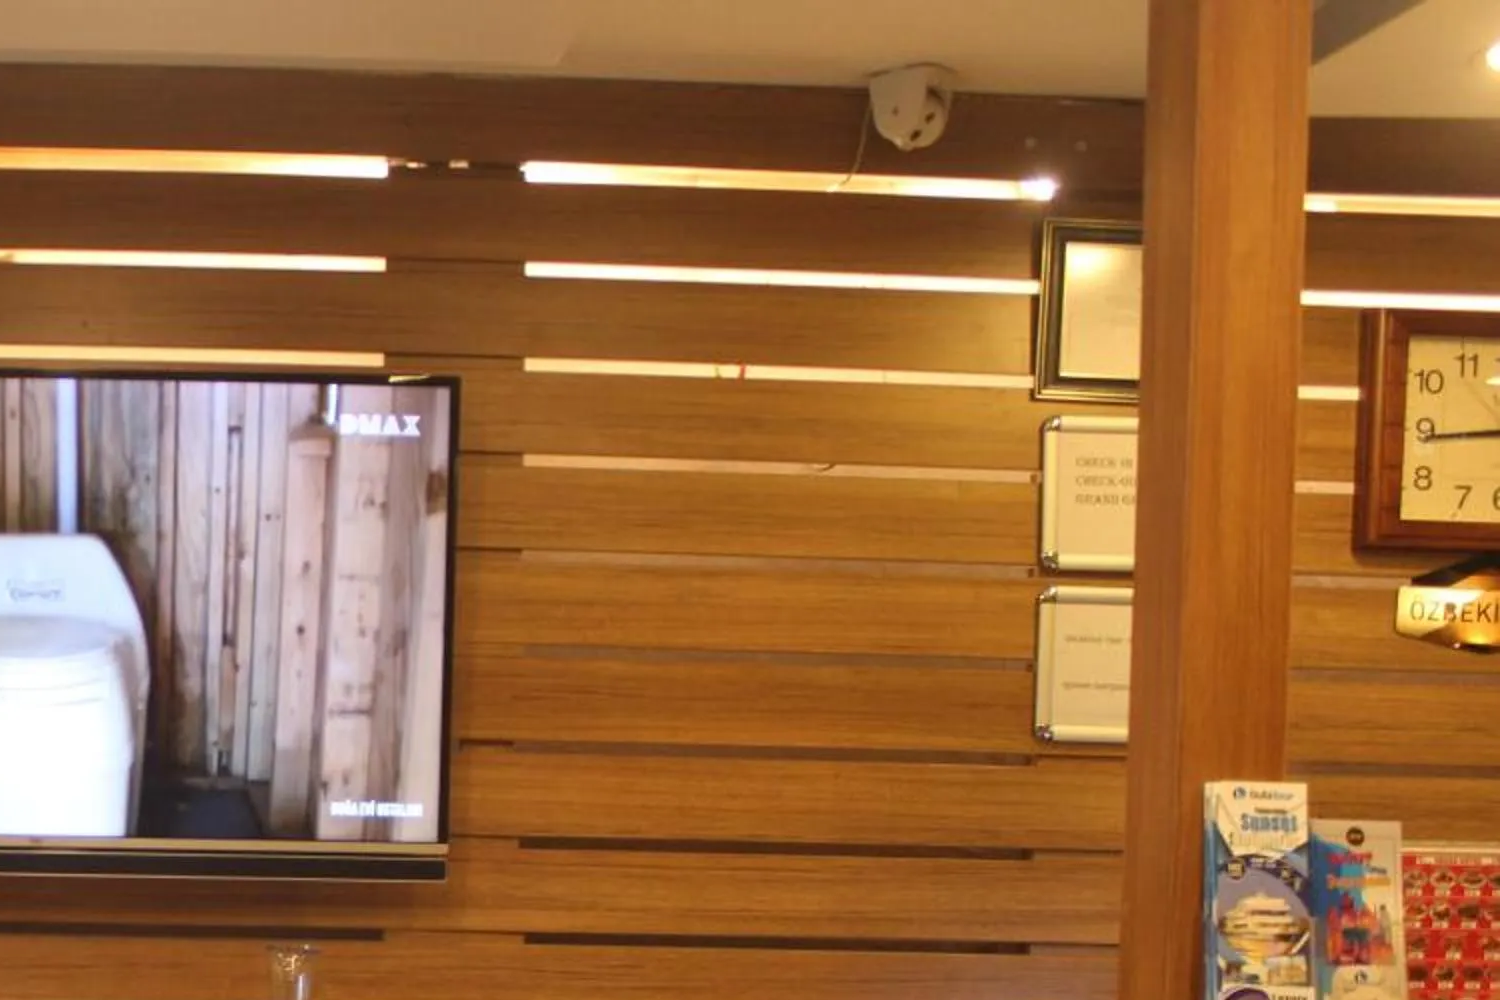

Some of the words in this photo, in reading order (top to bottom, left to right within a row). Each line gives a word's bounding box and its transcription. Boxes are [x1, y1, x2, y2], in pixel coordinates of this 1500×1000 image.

[1454, 353, 1479, 379] 11
[1414, 368, 1445, 395] 10
[339, 412, 421, 437] DMAX
[1415, 416, 1436, 444] 9
[1413, 465, 1433, 492] 8
[1454, 484, 1474, 511] 7
